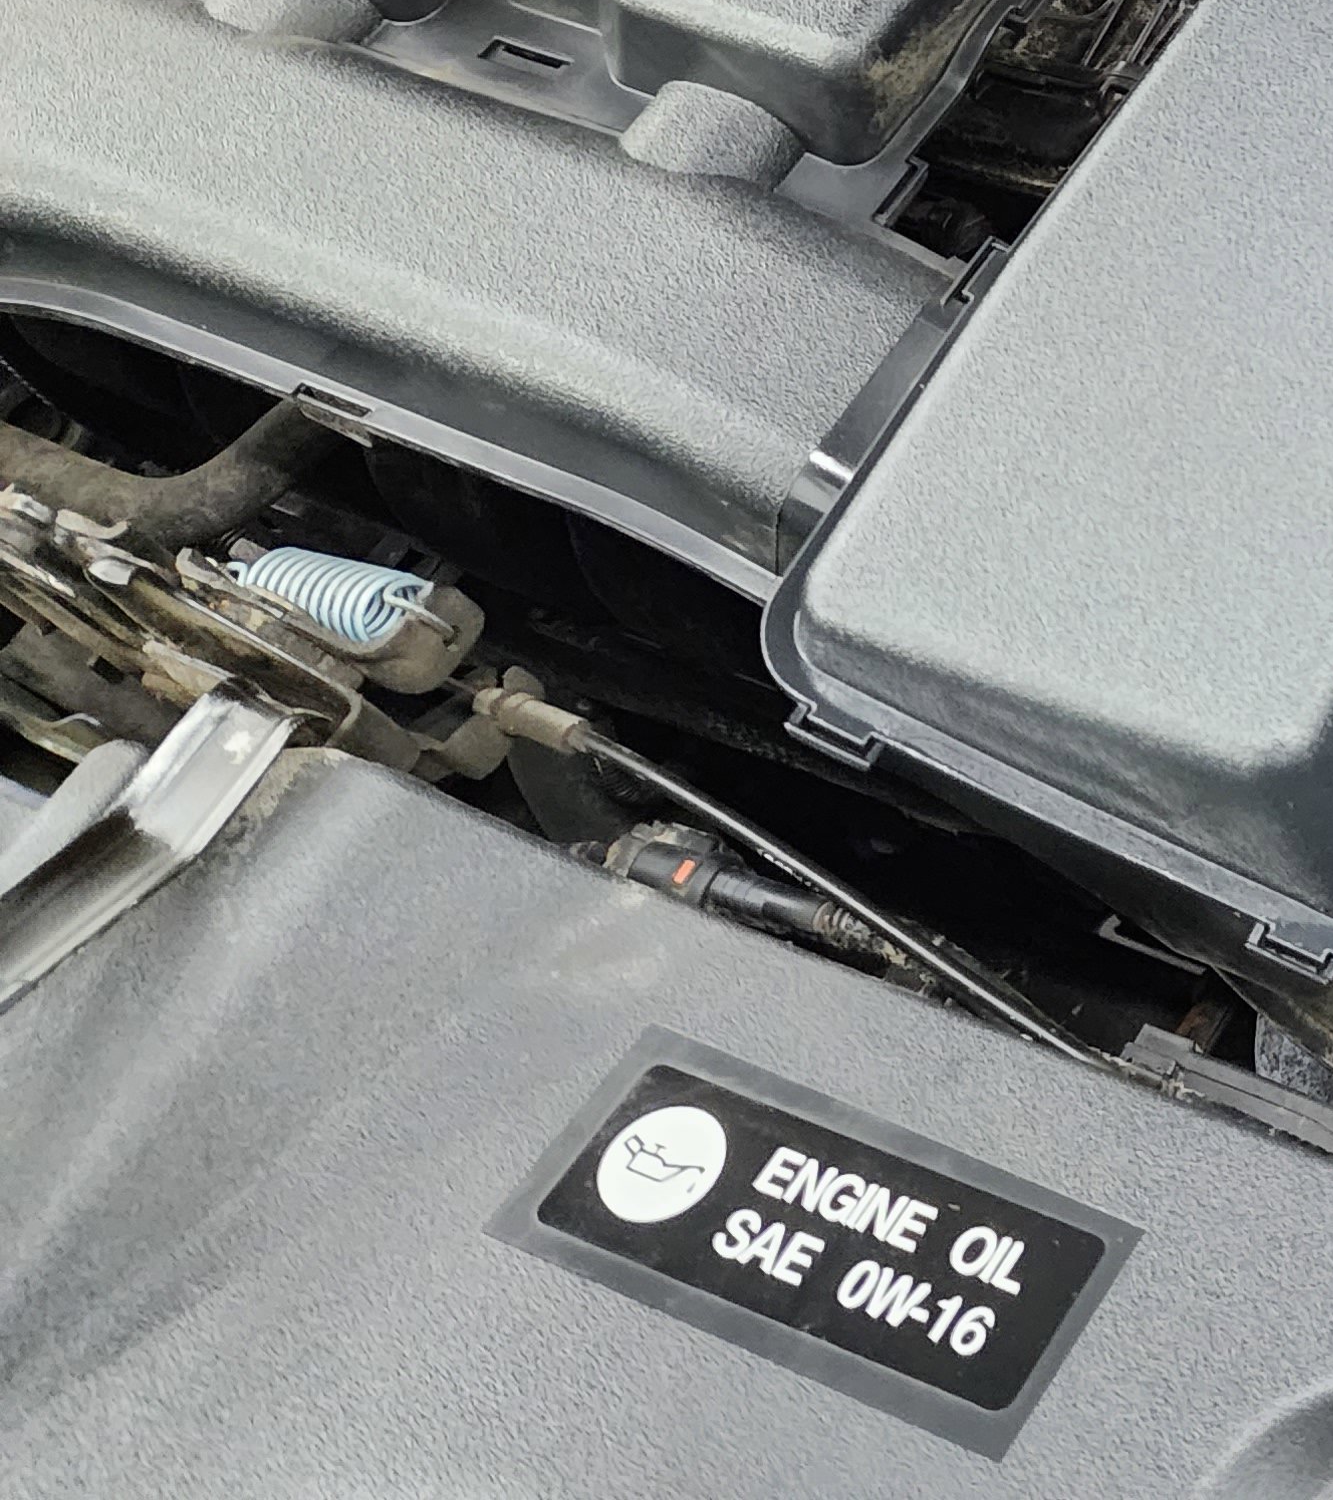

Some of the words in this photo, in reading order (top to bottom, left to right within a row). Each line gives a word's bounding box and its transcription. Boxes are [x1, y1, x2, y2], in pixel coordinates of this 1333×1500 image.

[711, 1209, 825, 1287] SAE
[836, 1260, 996, 1357] 0W-16
[752, 1147, 938, 1252] ENGINE
[949, 1227, 1025, 1296] OIL
